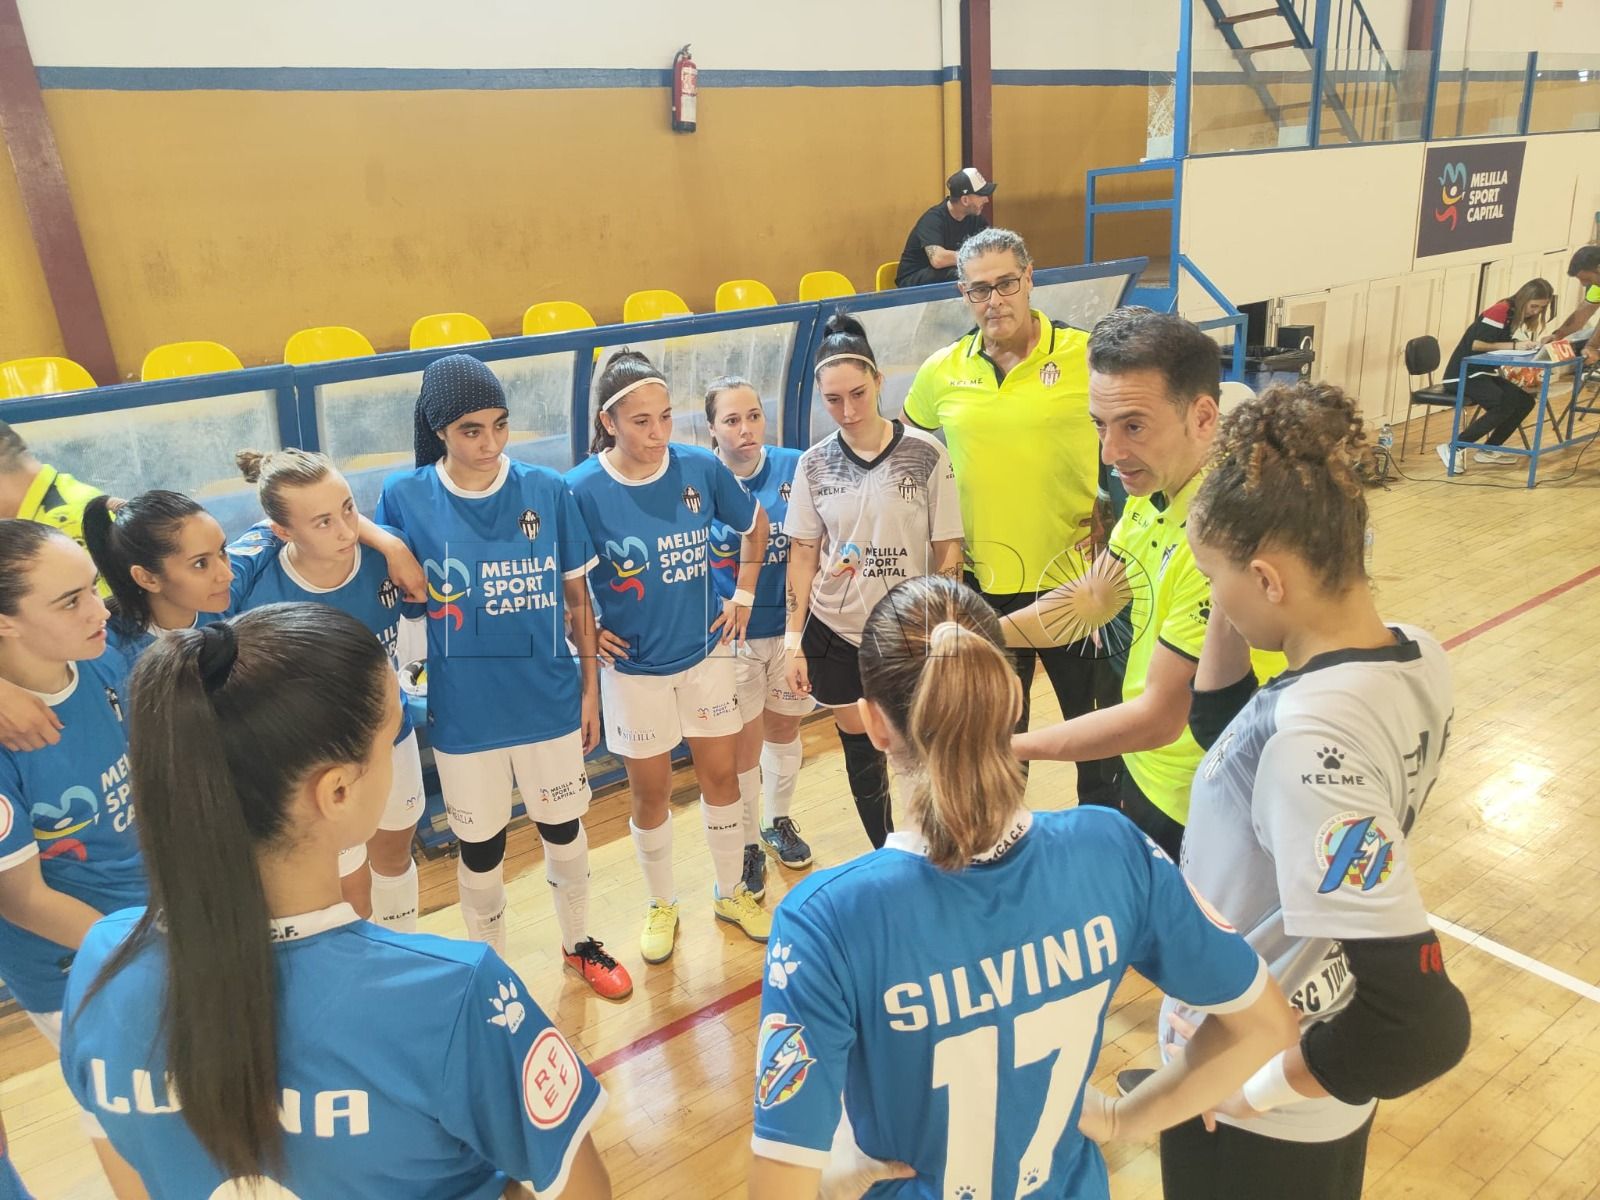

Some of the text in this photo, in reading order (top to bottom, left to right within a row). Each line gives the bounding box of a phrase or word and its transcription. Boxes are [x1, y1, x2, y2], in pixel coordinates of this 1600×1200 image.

[1470, 170, 1508, 188] MELILLA
[1468, 188, 1500, 206] SPORT
[1466, 204, 1504, 223] CAPITAL
[818, 487, 846, 497] KELME
[865, 547, 908, 558] MELILLA
[481, 556, 557, 579] MELILLA
[864, 557, 898, 568] SPORT
[862, 567, 907, 579] CAPITAL
[483, 576, 543, 599] SPORT
[485, 591, 558, 616] CAPITAL
[550, 781, 573, 793] MELILLA
[1301, 774, 1366, 786] KELME
[883, 916, 1118, 1032] SILVINA
[932, 980, 1111, 1200] 17
